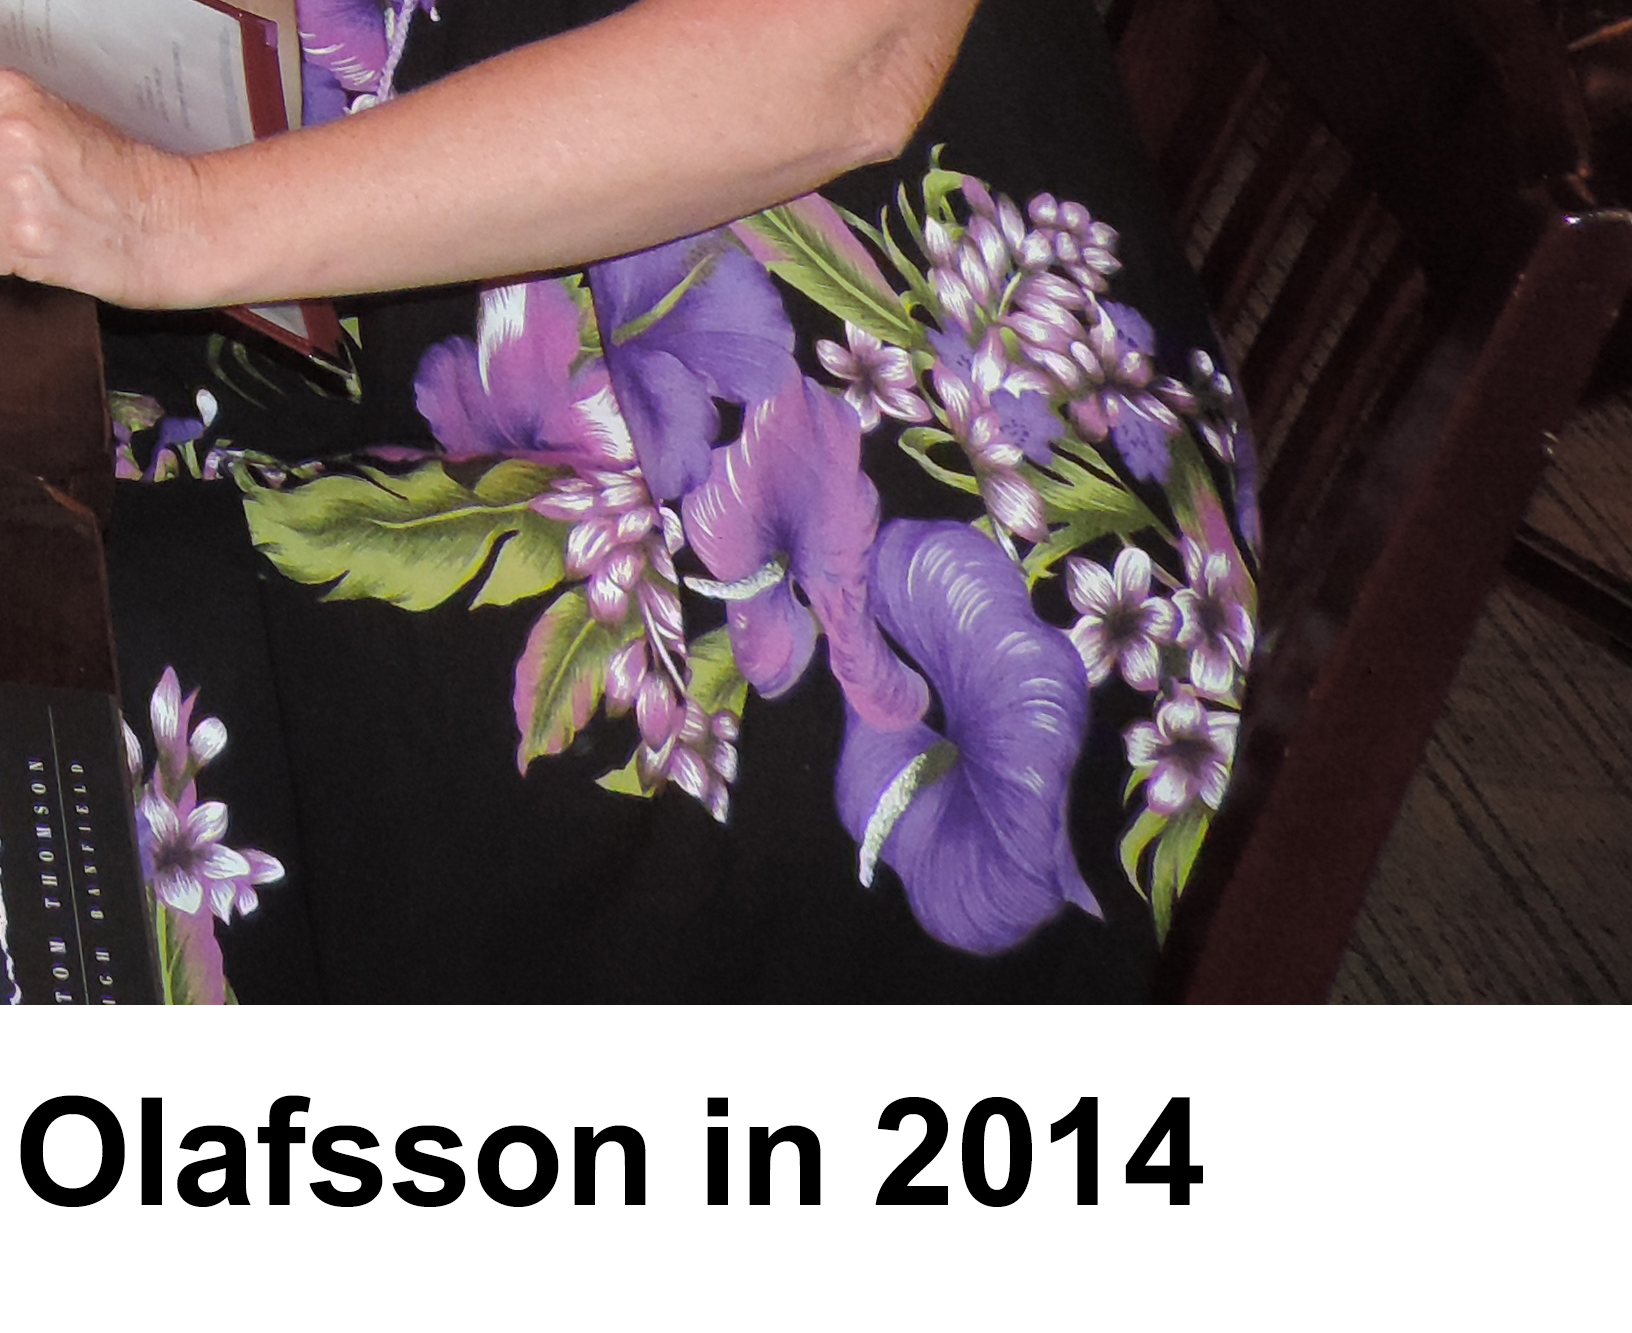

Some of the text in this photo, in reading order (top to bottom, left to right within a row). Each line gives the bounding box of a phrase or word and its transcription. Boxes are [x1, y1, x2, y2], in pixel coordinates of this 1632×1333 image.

[28, 760, 73, 1004] TOM THOMSON
[70, 763, 105, 920] BANFIELD
